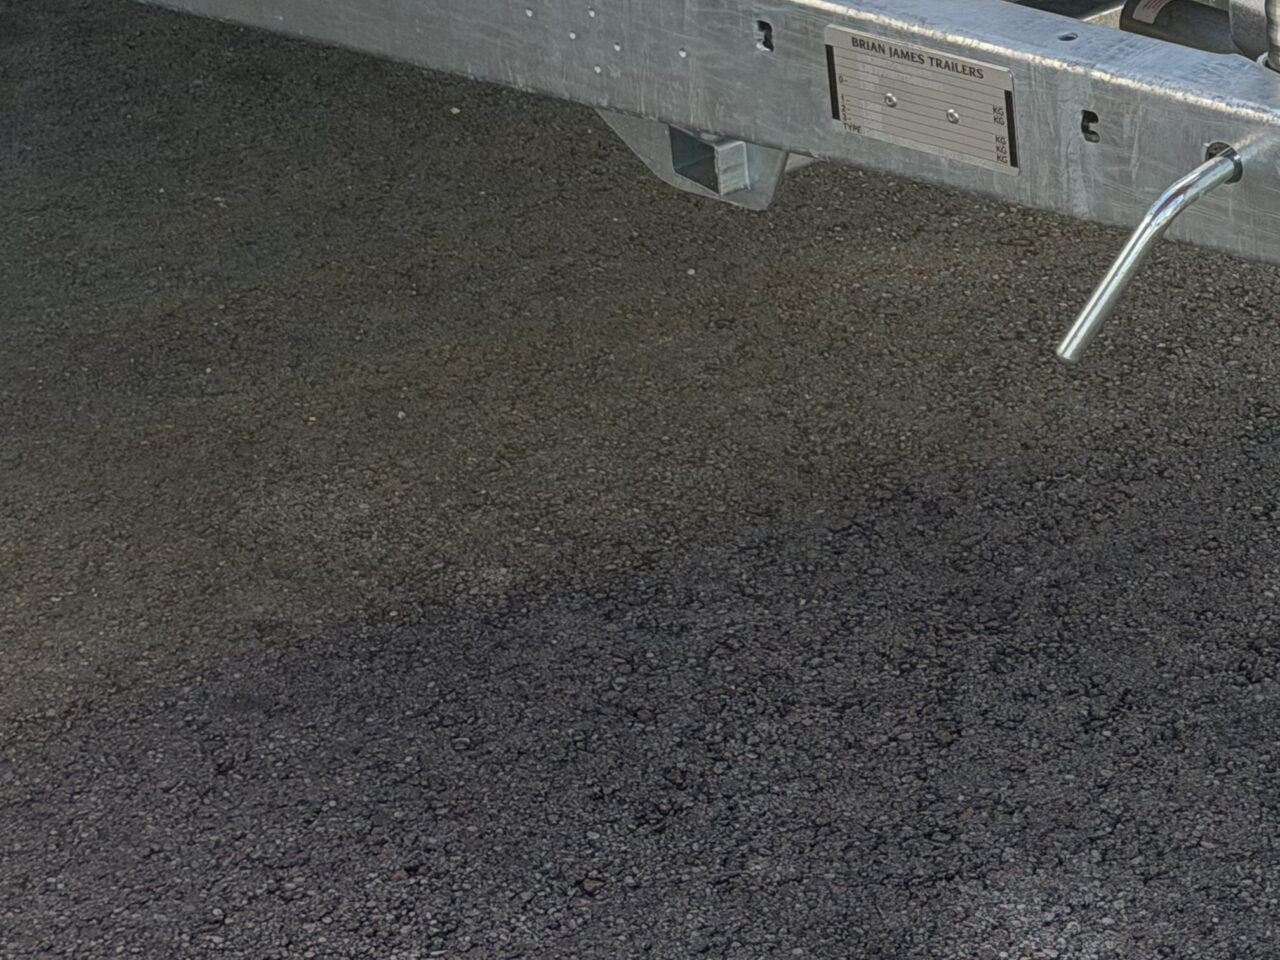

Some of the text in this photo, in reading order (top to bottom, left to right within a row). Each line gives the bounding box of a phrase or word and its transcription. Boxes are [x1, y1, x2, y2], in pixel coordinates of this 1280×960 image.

[851, 36, 984, 79] BRIAN JAMES TRAILERS
[843, 122, 862, 134] TYPE
